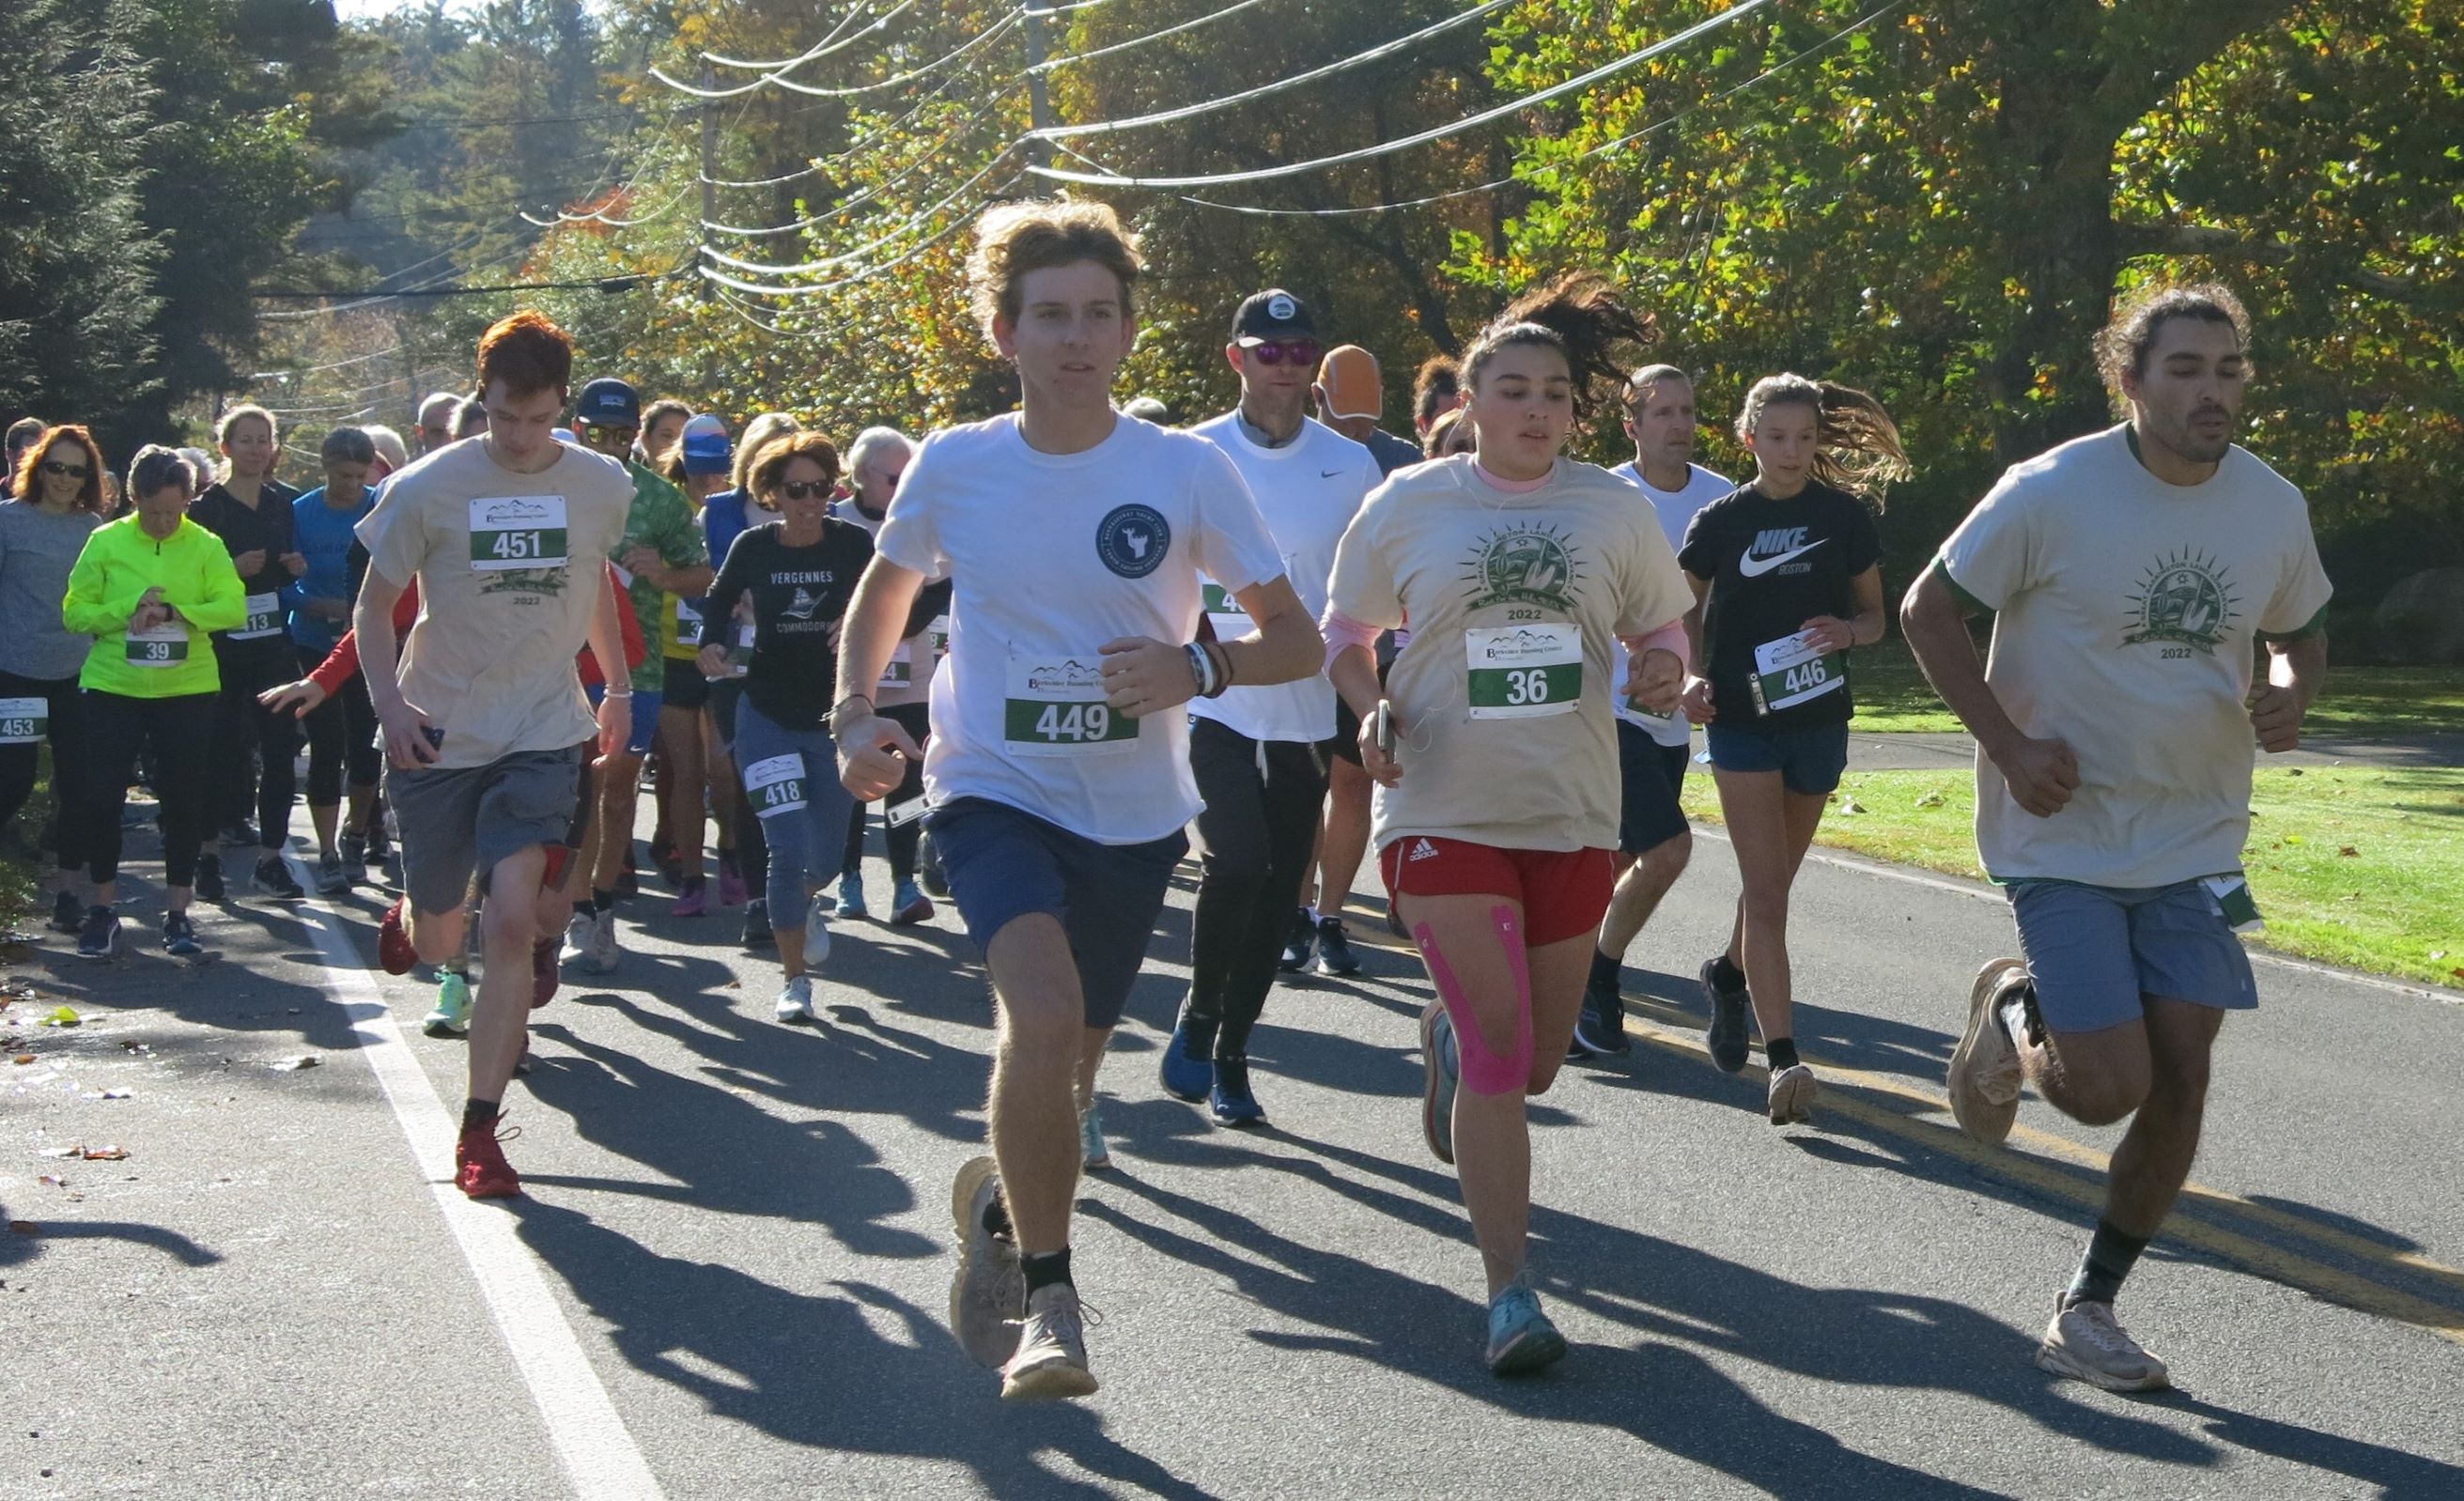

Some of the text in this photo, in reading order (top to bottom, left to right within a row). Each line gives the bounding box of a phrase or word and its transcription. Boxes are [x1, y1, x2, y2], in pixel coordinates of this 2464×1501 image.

[492, 531, 540, 558] 451
[1750, 526, 1809, 554] NIKE
[770, 571, 833, 584] VERGENNES
[1778, 562, 1812, 576] BOSTON
[1508, 610, 1542, 620] 2022
[147, 642, 169, 659] 39
[2161, 648, 2192, 659] 2022
[1785, 658, 1826, 692] 446
[1506, 669, 1548, 704] 36
[2, 719, 34, 735] 453
[1036, 704, 1108, 741] 449
[766, 781, 800, 805] 418
[1409, 848, 1439, 861] adidas
